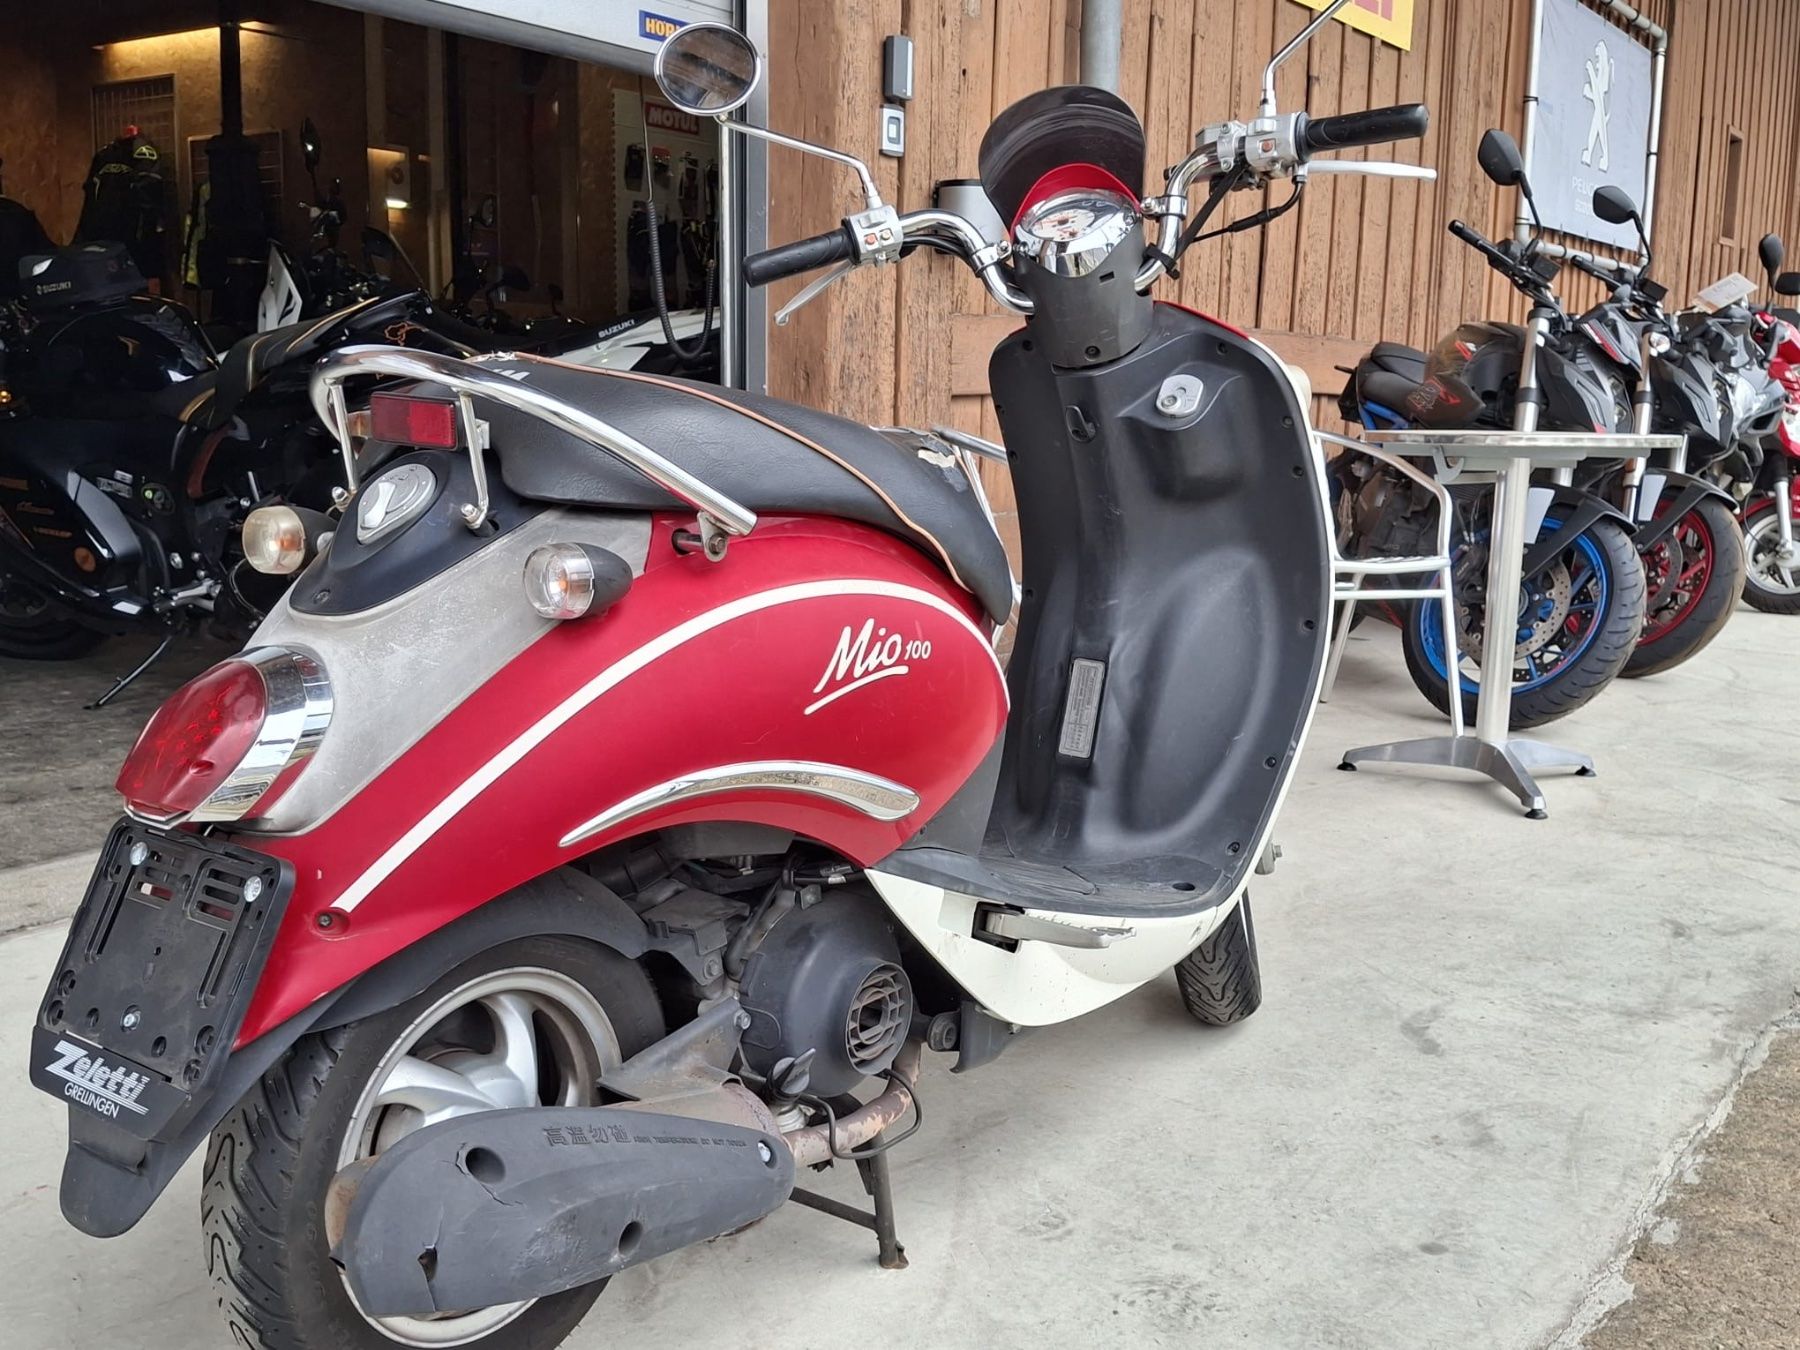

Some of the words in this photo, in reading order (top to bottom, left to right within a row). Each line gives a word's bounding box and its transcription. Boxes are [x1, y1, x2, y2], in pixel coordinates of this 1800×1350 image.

[647, 106, 698, 132] MOTUL
[598, 318, 635, 338] SUZUKI
[812, 617, 903, 694] Mio
[903, 639, 932, 661] 100
[44, 1039, 151, 1116] Zeletti
[64, 1081, 120, 1119] GRELLINGEN
